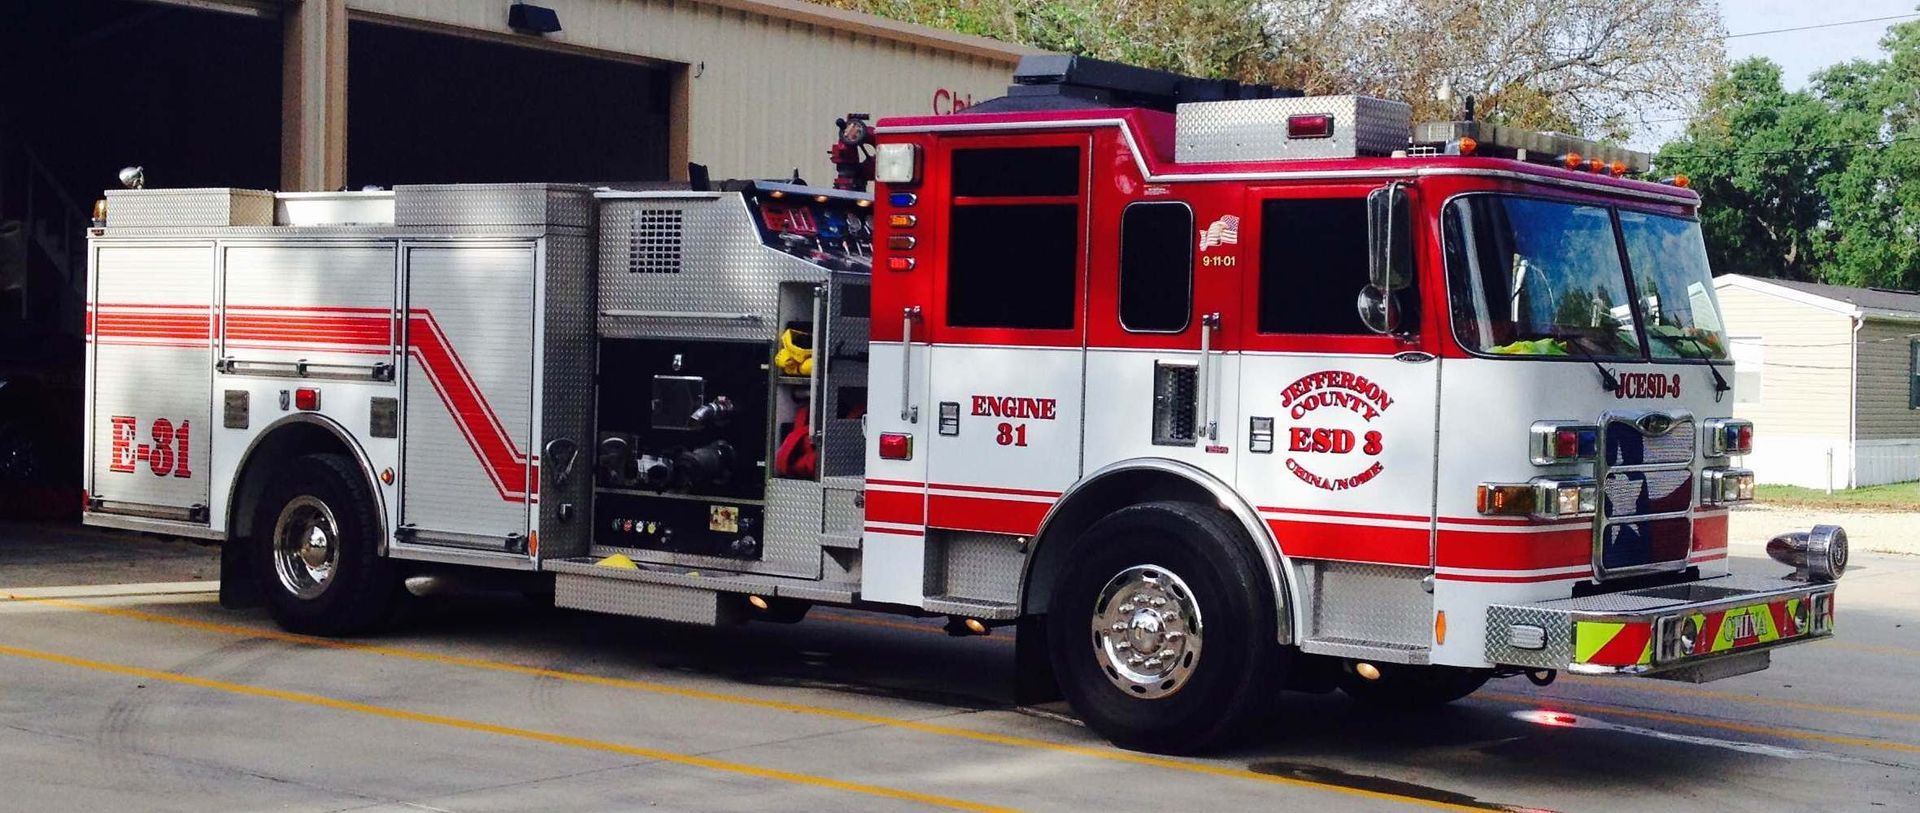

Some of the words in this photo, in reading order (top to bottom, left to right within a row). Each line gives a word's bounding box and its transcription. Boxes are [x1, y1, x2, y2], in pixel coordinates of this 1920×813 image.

[1280, 370, 1394, 412] JEFFERSON
[1615, 373, 1680, 399] JCESD-3
[971, 395, 1056, 420] ENGINE
[1291, 391, 1380, 422] COUNTY
[110, 415, 191, 478] E-31
[996, 422, 1028, 447] 31
[1288, 427, 1355, 454] ESD
[1363, 430, 1383, 455] 3
[1724, 610, 1768, 642] CHINA
